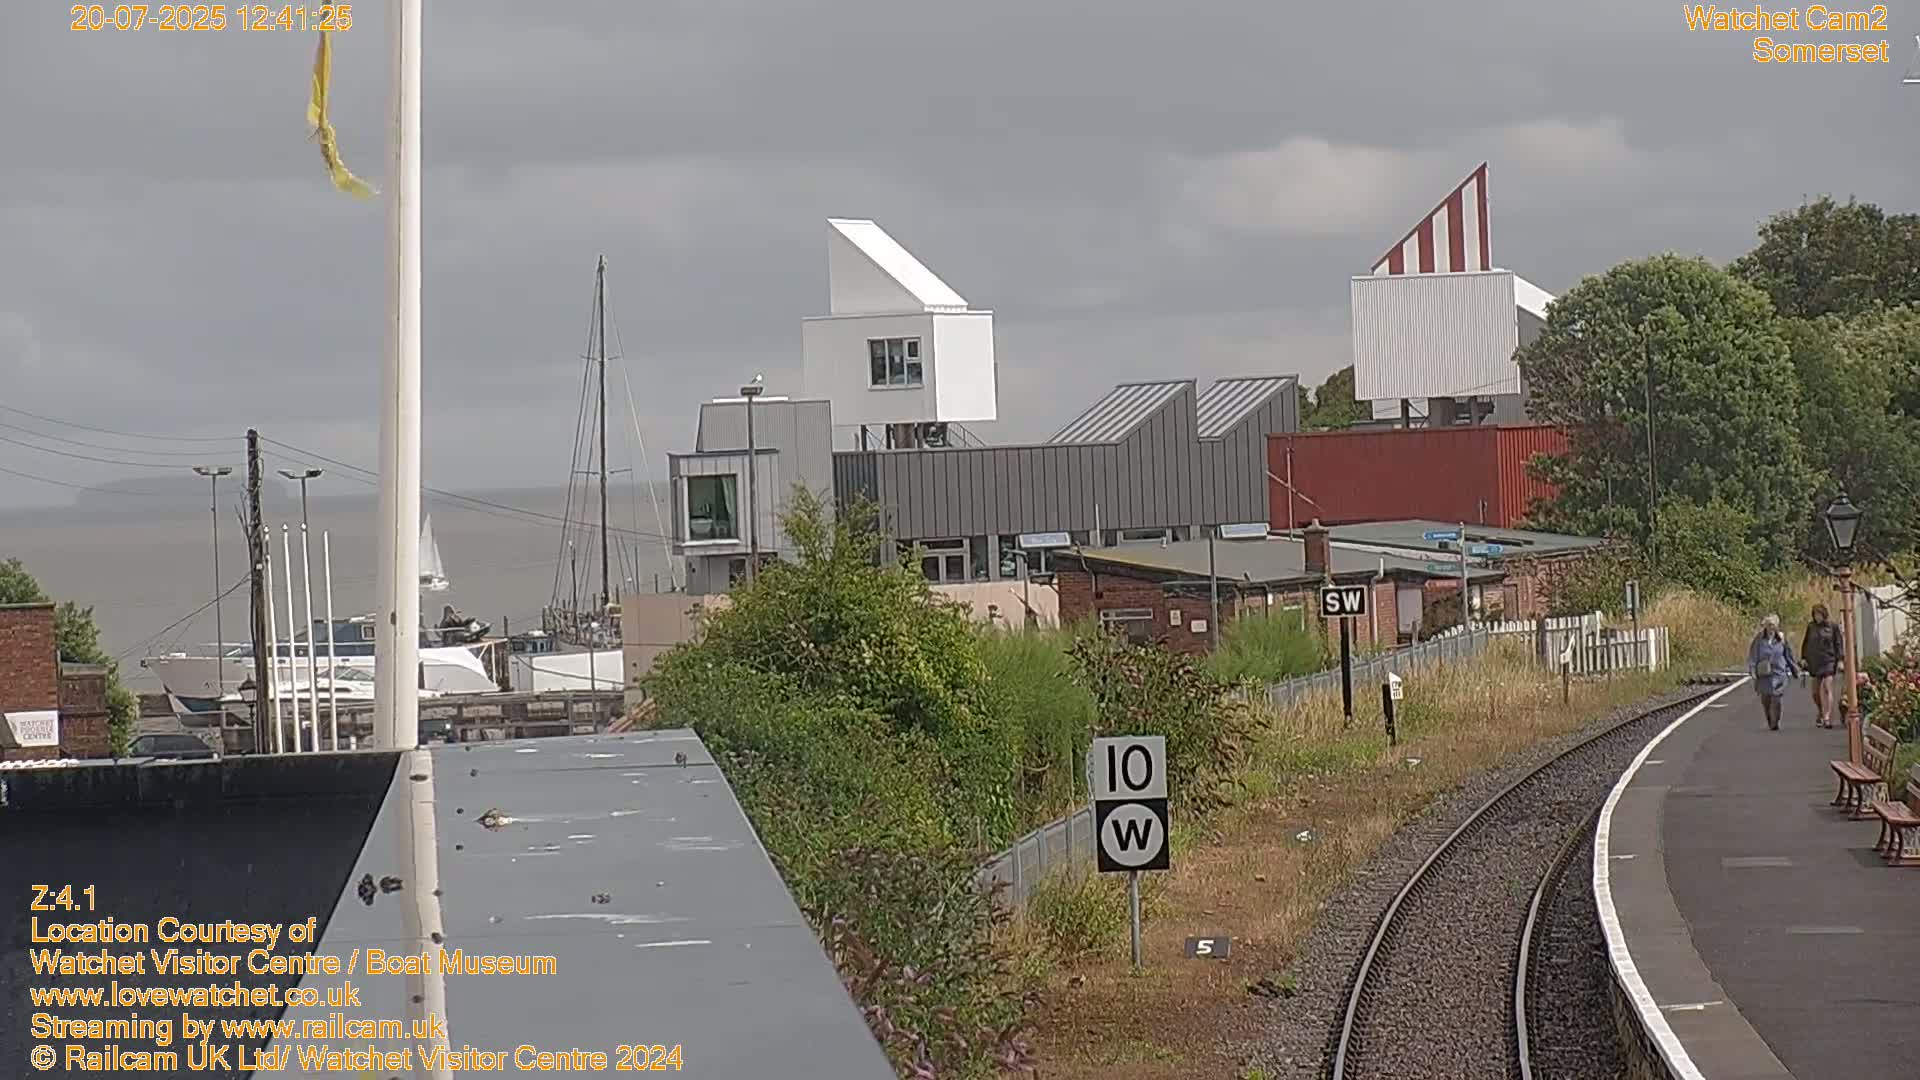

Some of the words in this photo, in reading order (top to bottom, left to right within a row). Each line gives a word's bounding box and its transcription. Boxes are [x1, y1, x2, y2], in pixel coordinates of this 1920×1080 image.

[1325, 590, 1361, 612] SW
[1112, 818, 1152, 851] W
[1196, 939, 1214, 955] 5
